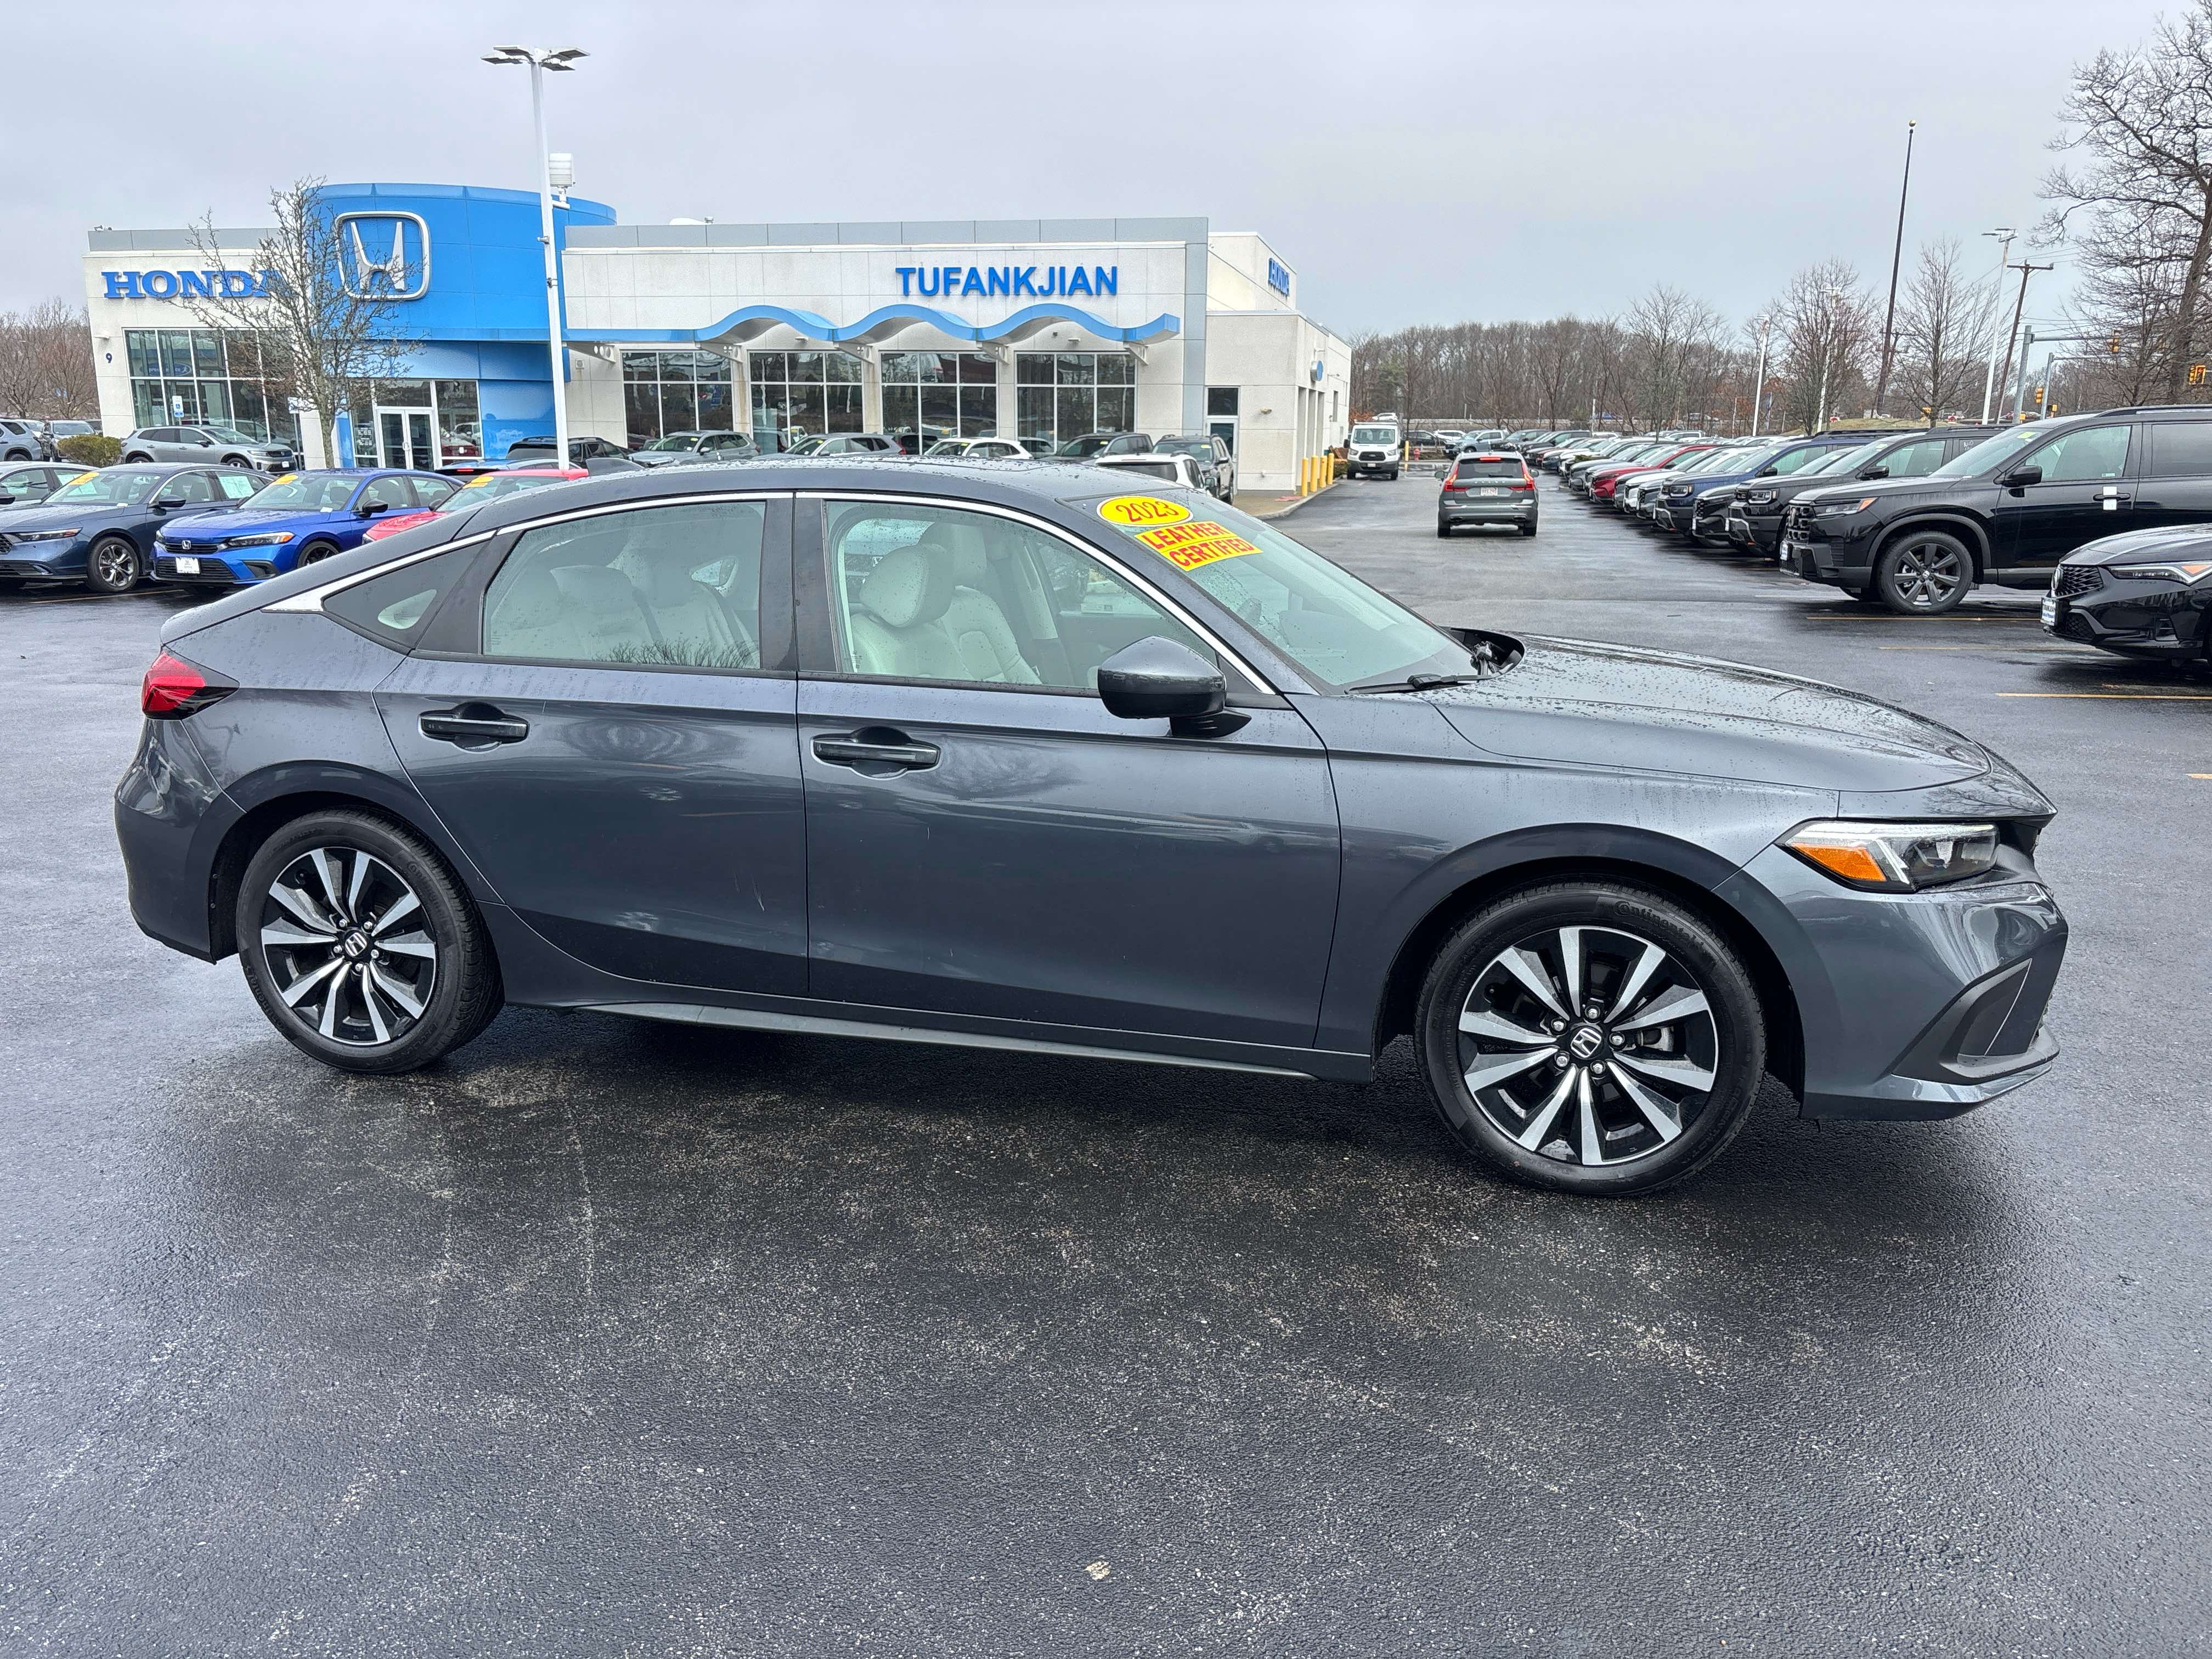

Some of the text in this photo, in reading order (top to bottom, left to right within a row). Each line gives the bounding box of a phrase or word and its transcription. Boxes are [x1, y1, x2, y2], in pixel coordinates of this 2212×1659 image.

[101, 270, 296, 298] HONDA
[895, 266, 1118, 296] TUFANKJIAN
[106, 353, 112, 364] 9
[1115, 501, 1179, 522] 2023
[1141, 523, 1229, 549] LEATHER
[1169, 538, 1255, 566] CERTIFIED
